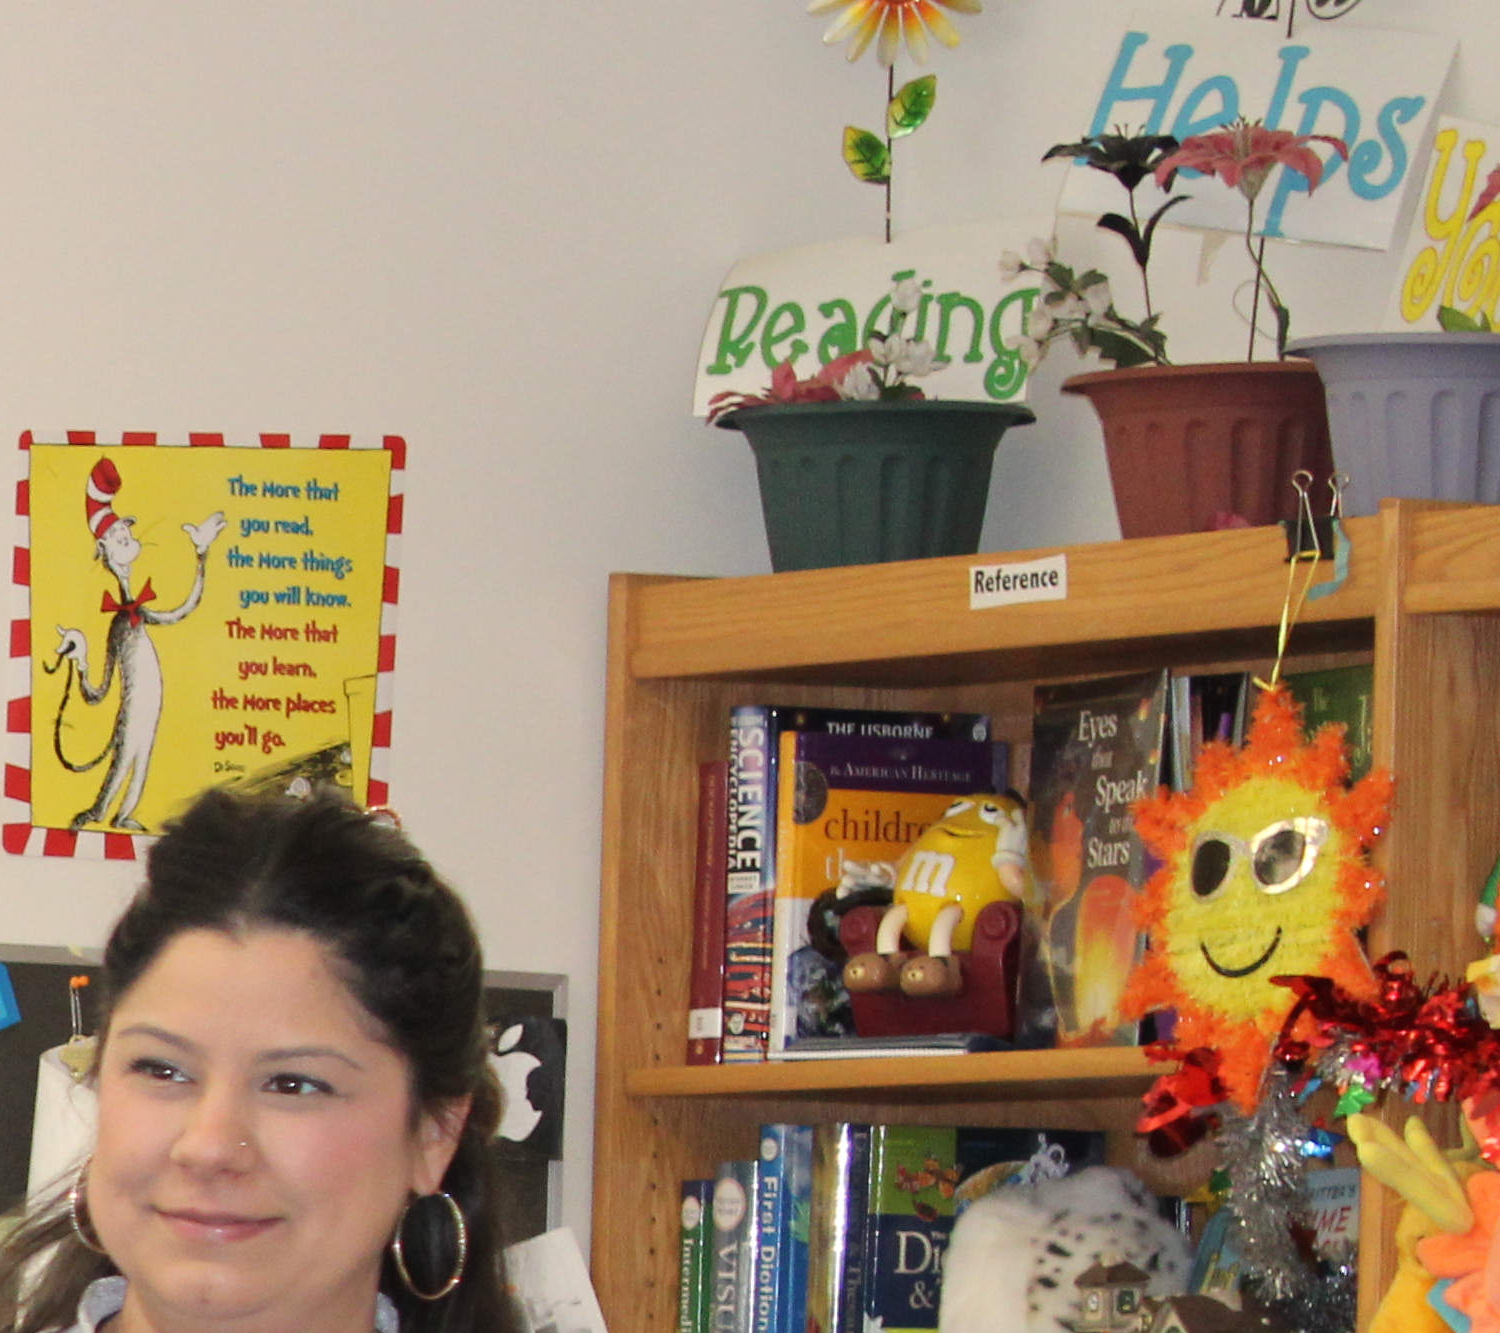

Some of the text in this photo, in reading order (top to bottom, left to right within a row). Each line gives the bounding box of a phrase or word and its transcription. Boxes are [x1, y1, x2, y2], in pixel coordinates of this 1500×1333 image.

[1073, 32, 1426, 236] Helps
[707, 270, 1041, 400] Reading
[228, 474, 257, 497] The
[306, 478, 340, 501] that
[241, 518, 269, 537] you
[227, 545, 253, 568] the
[303, 549, 353, 579] things
[240, 589, 269, 609] you
[274, 586, 300, 605] will
[974, 568, 1059, 596] Reference
[225, 617, 255, 639] The
[305, 620, 338, 643] that
[238, 661, 268, 680] you
[211, 687, 238, 710] the
[286, 692, 336, 718] places
[827, 722, 933, 739] THE USBORNE
[1078, 710, 1118, 748] Eyes
[737, 727, 764, 869] SCIENCE
[1096, 770, 1147, 815] Speak
[1088, 837, 1130, 869] Stars
[762, 1176, 778, 1235] First
